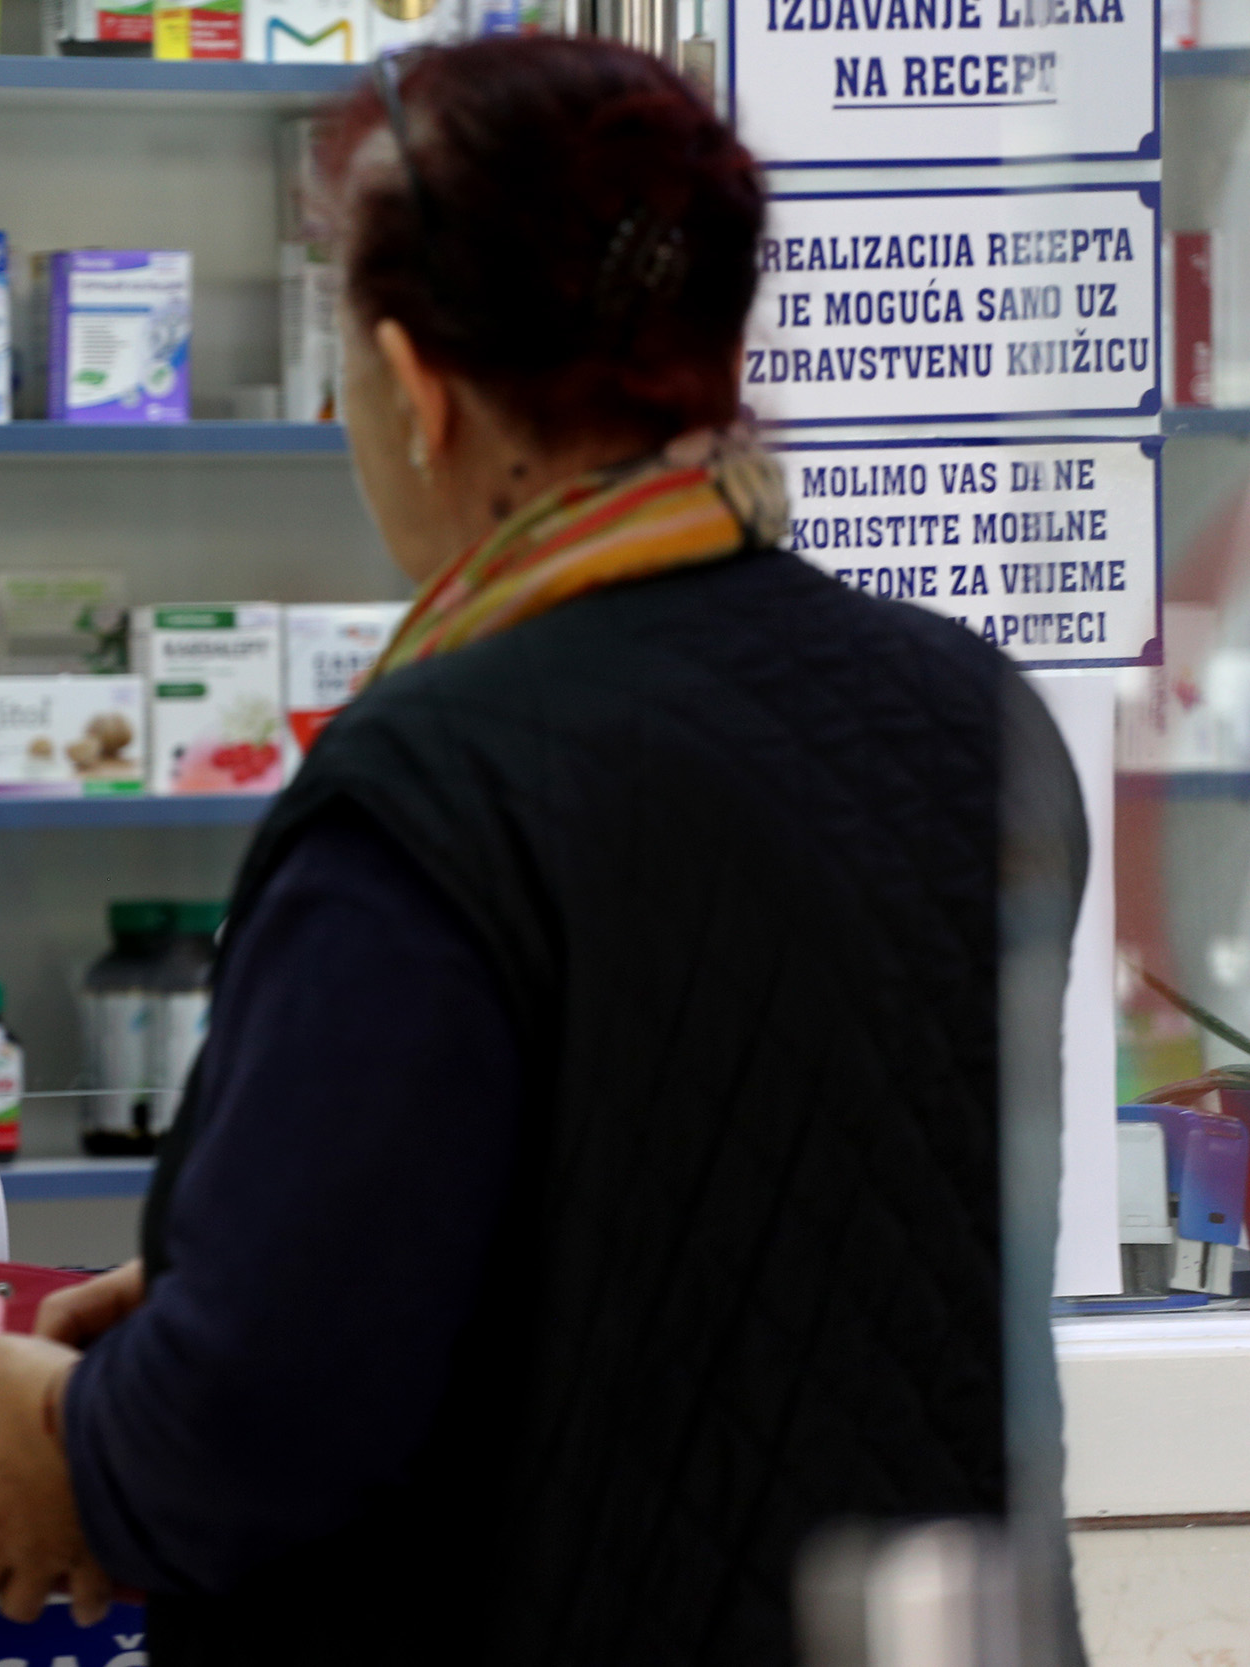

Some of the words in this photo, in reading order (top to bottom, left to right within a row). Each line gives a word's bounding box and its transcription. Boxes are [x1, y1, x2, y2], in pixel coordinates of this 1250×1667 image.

[766, 0, 981, 30] IZDAVANJE
[834, 57, 887, 97] NA
[759, 234, 974, 272] REALIZACIJA
[778, 293, 812, 328] JE
[824, 278, 964, 326] MOGUĆA
[1076, 283, 1118, 318] UZ
[747, 343, 993, 384] ZDRAVSTVENU
[802, 464, 928, 499] MOLIMO
[939, 461, 998, 495] VAS
[1053, 458, 1096, 491] NE
[790, 513, 960, 552] KORISTITE
[950, 564, 989, 596] ZA
